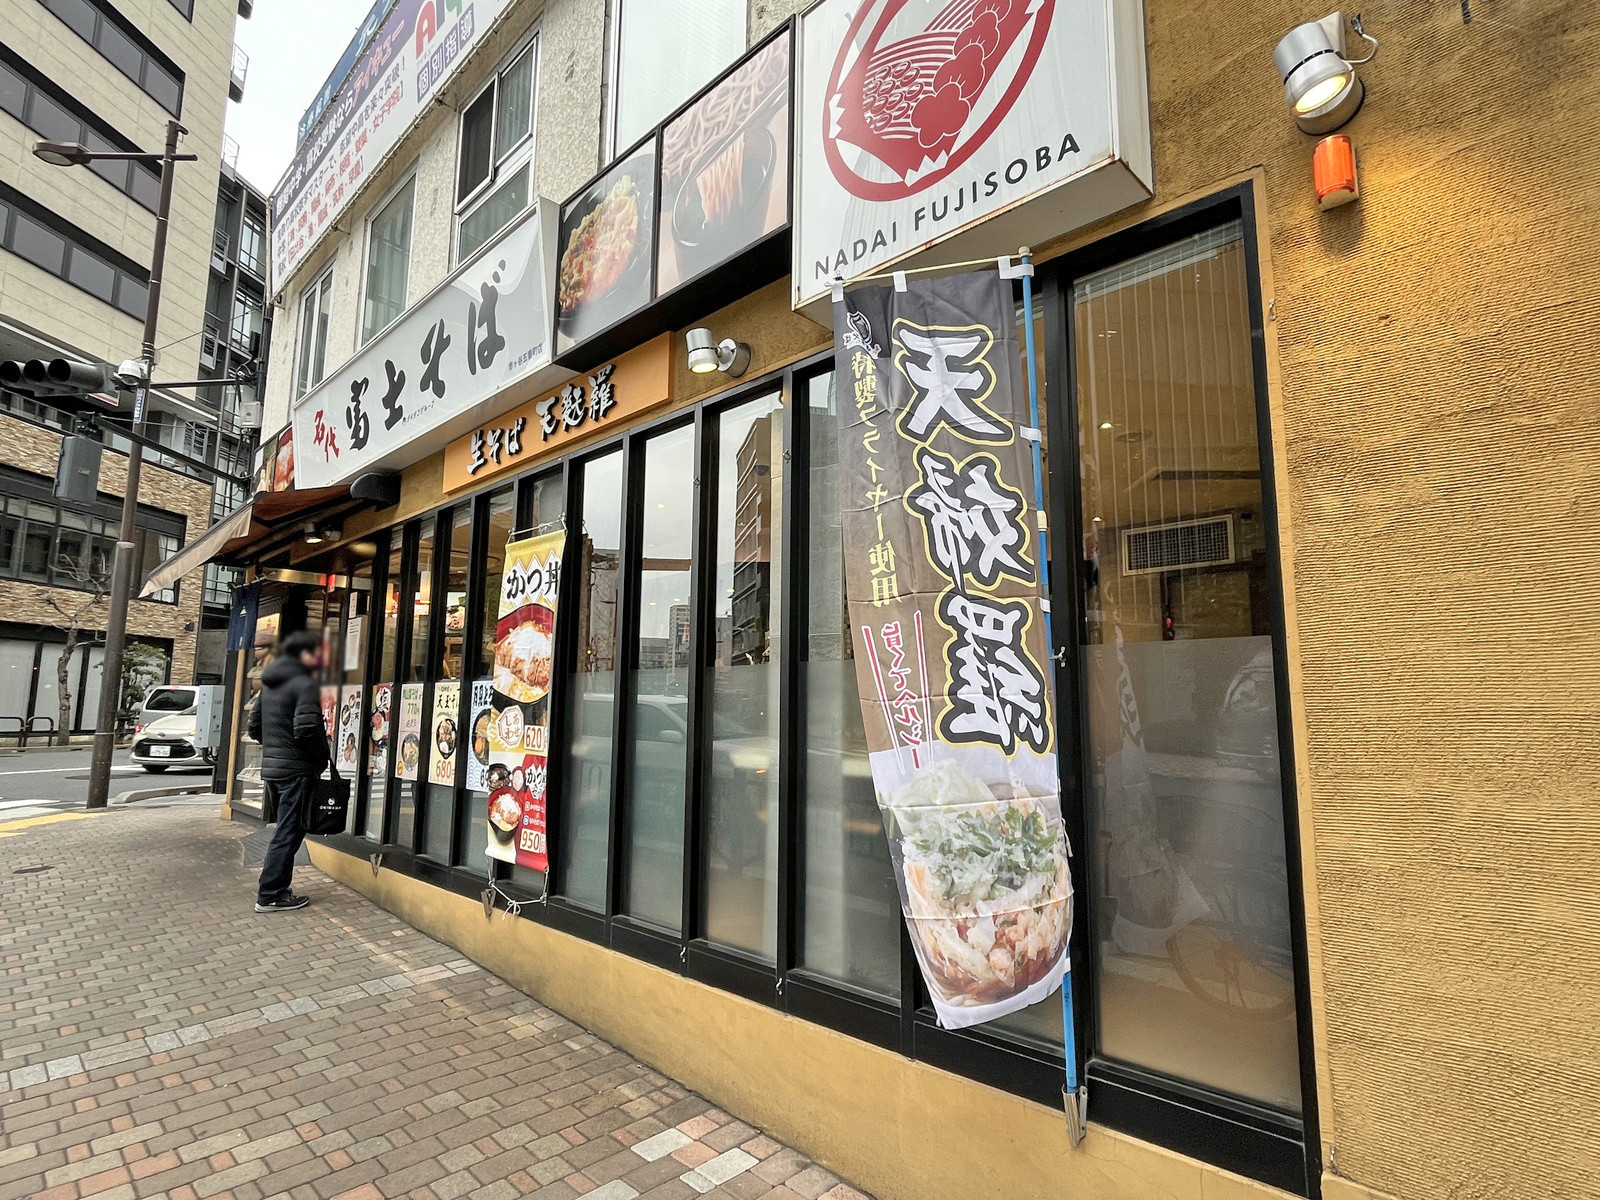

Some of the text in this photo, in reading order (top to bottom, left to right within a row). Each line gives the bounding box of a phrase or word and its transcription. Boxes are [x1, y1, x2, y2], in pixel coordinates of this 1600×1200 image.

[418, 9, 473, 100] 個別指導
[814, 133, 1081, 280] NADAI FUJISOBA
[466, 416, 526, 476] 生そば
[506, 561, 561, 599] かつ丼
[525, 726, 542, 749] 620
[521, 830, 540, 851] 950
